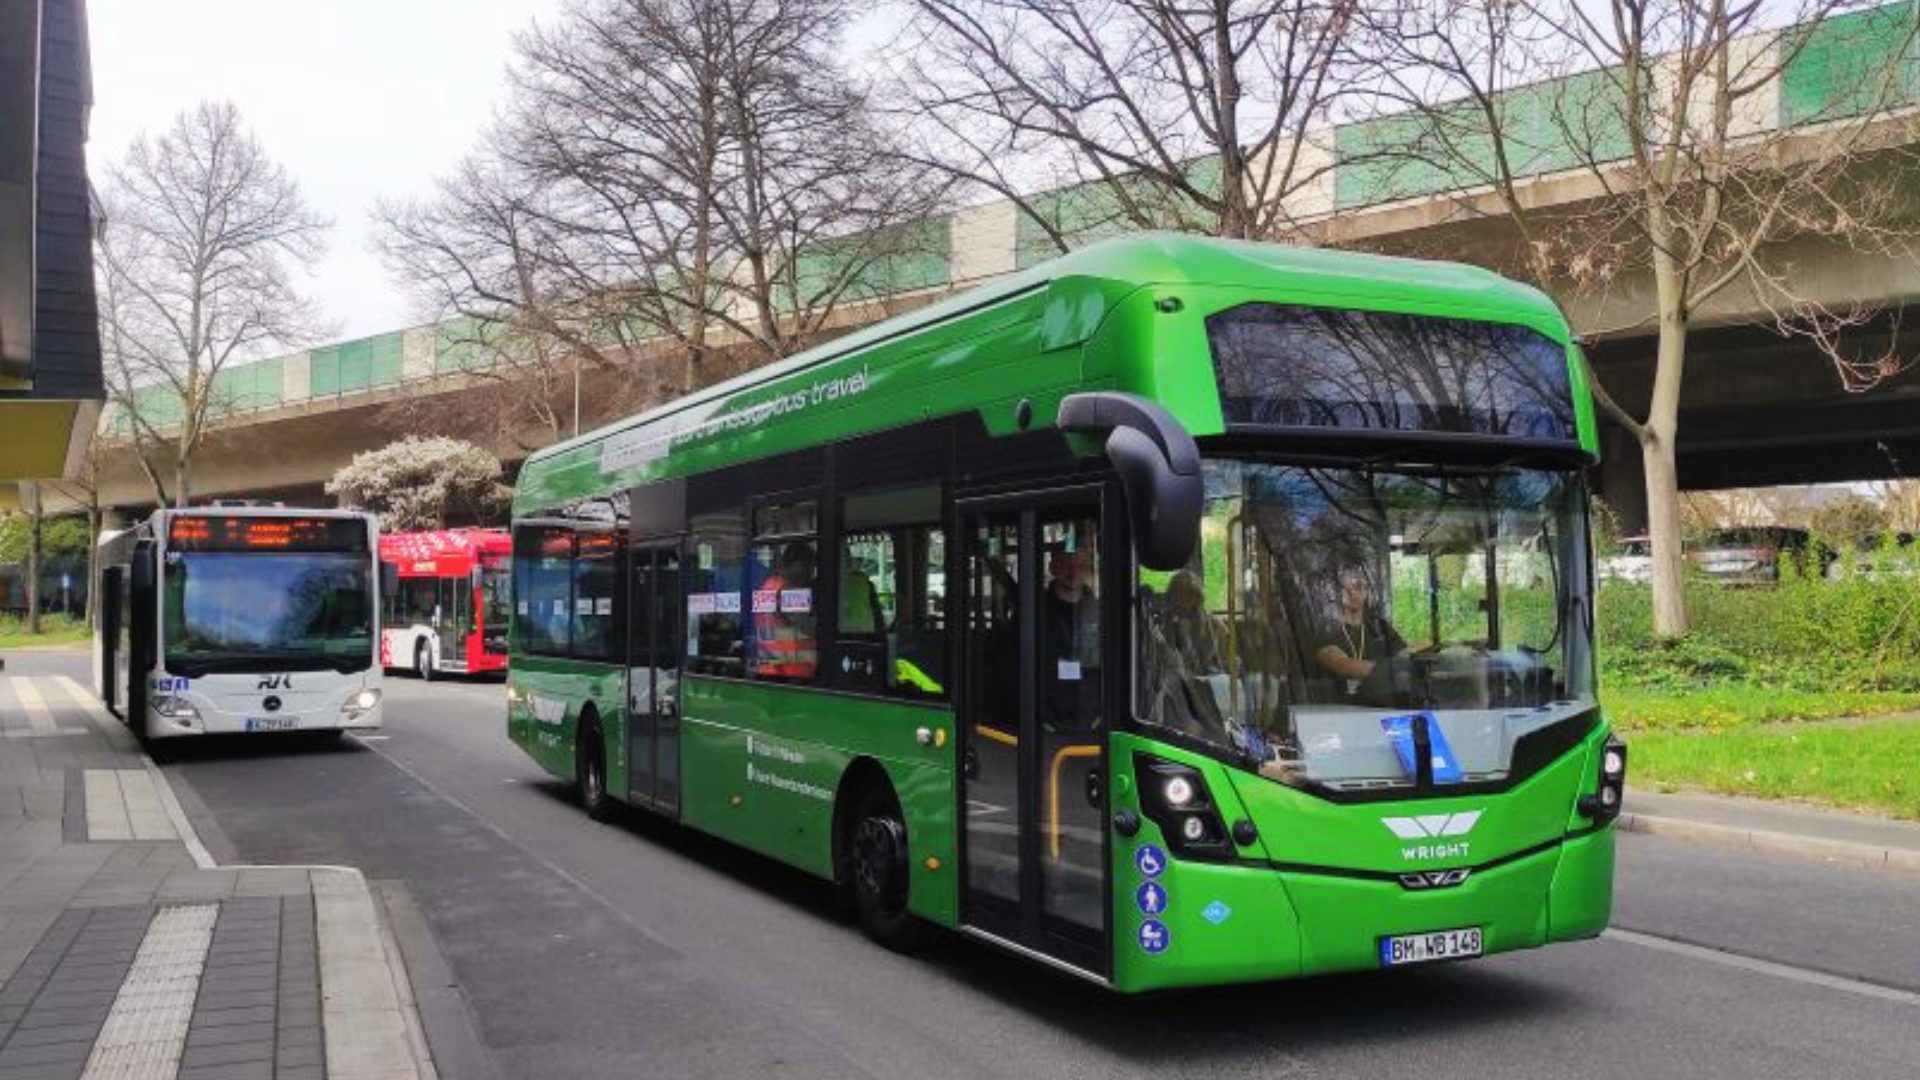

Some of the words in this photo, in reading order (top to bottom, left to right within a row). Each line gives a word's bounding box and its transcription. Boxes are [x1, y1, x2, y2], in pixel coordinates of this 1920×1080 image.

[812, 362, 869, 404] travel
[1402, 843, 1470, 860] WRIGHT
[1392, 938, 1415, 960] BM
[1425, 934, 1446, 957] WB
